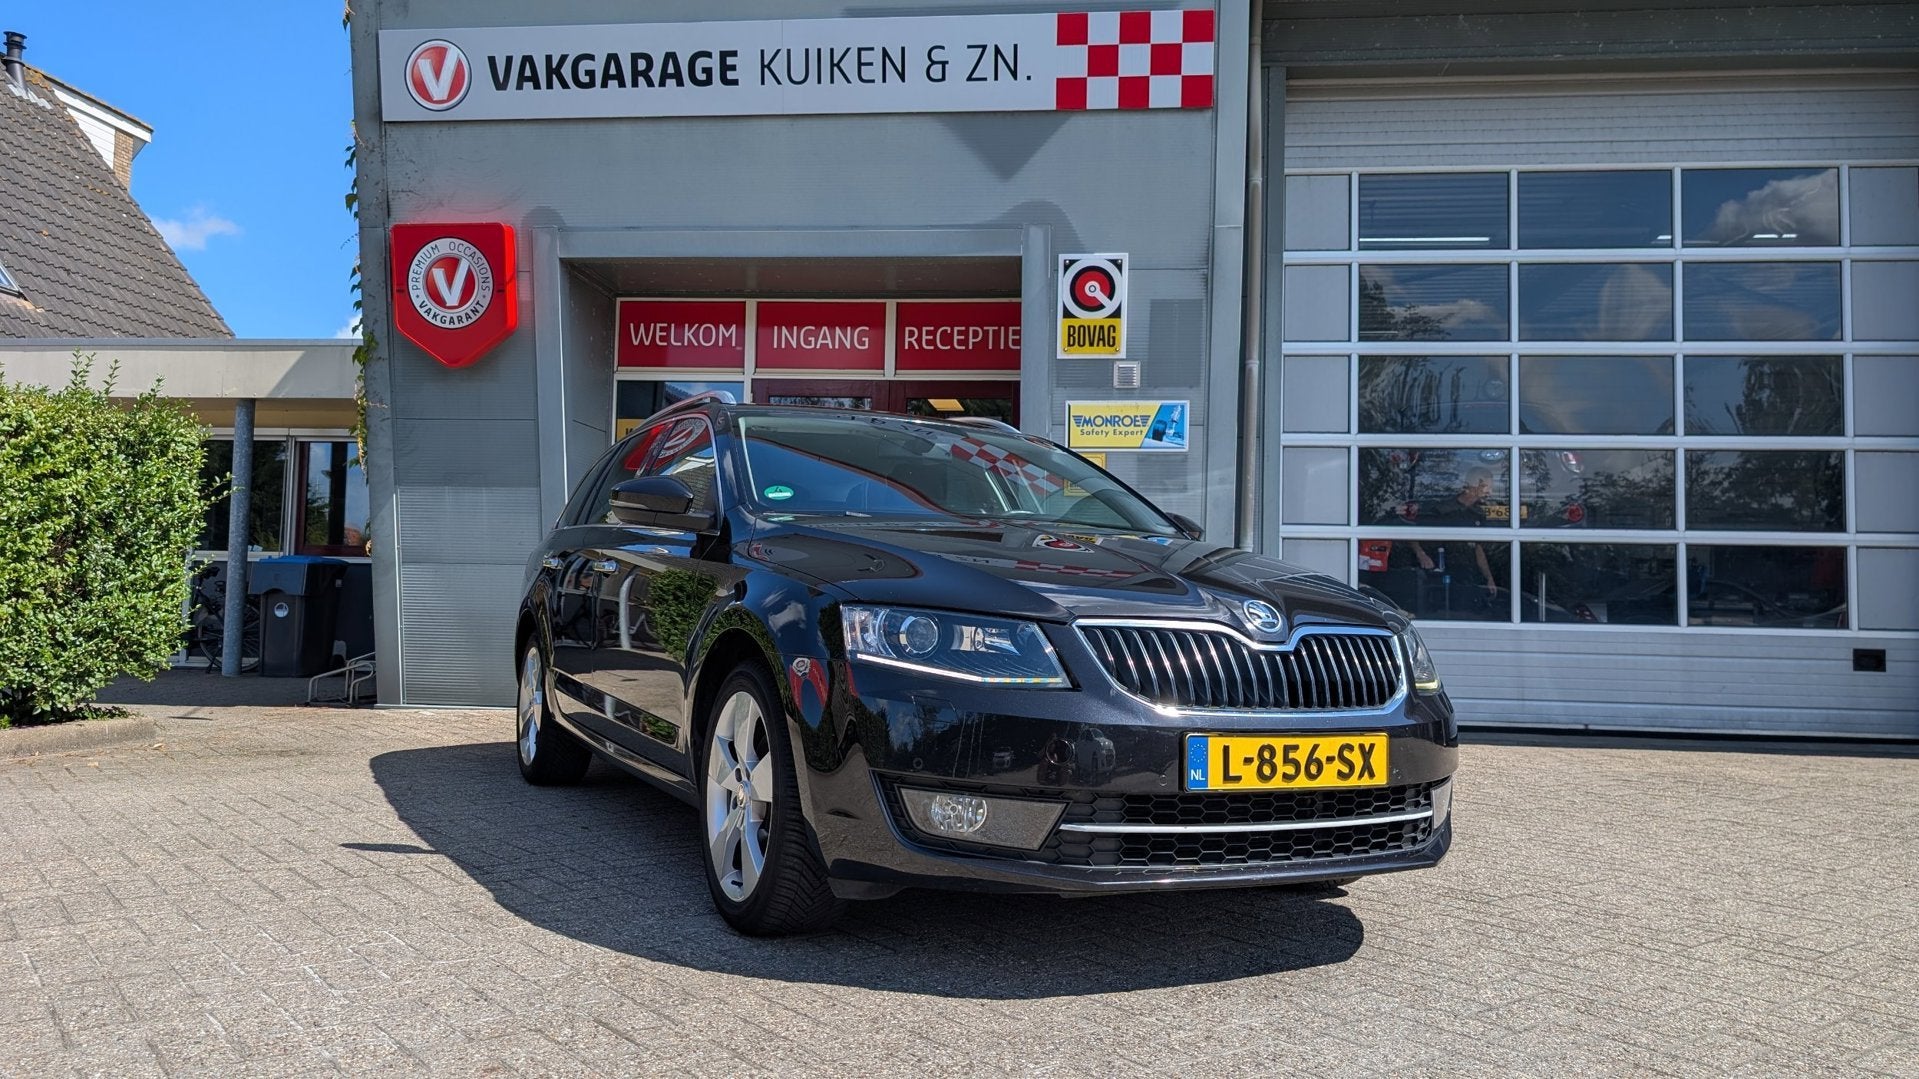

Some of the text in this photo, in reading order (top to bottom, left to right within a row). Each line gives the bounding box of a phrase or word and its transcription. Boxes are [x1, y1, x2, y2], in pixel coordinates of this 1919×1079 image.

[487, 43, 1032, 91] VAKGARAGE KUIKEN & ZN.
[412, 241, 491, 292] PREMIUM OCCASIONS
[418, 299, 485, 326] VAKGARANT
[629, 323, 737, 347] WELKOM
[773, 325, 870, 350] INGANG
[904, 326, 1021, 350] RECEPTIE
[1067, 324, 1117, 348] BOVAG
[1080, 429, 1144, 438] Safety Expert
[1081, 415, 1141, 428] MONROE
[1190, 769, 1206, 781] NL
[1222, 743, 1376, 784] L-856-SX
